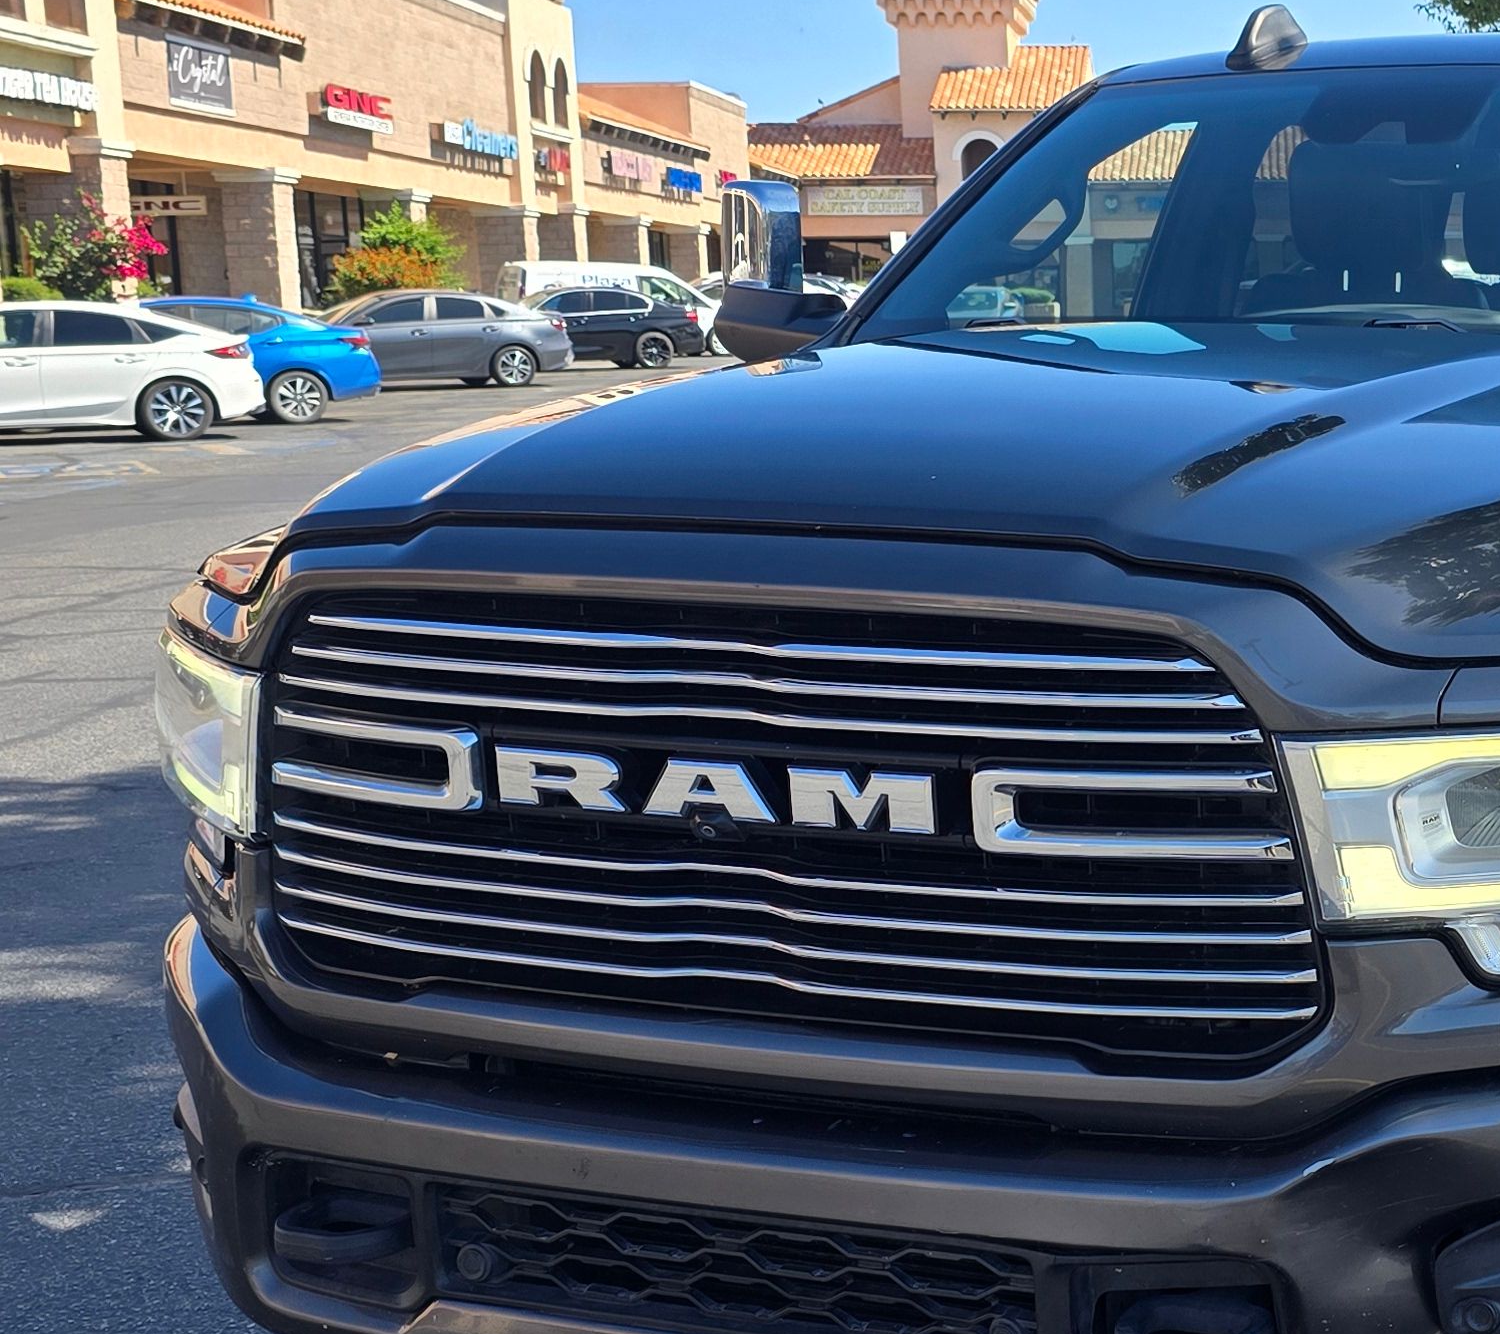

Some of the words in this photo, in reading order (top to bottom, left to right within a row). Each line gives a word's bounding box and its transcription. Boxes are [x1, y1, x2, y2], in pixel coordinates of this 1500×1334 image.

[325, 83, 393, 120] GNC
[463, 118, 517, 160] Cleaners
[824, 188, 854, 200] CAL
[495, 745, 936, 835] RAM
